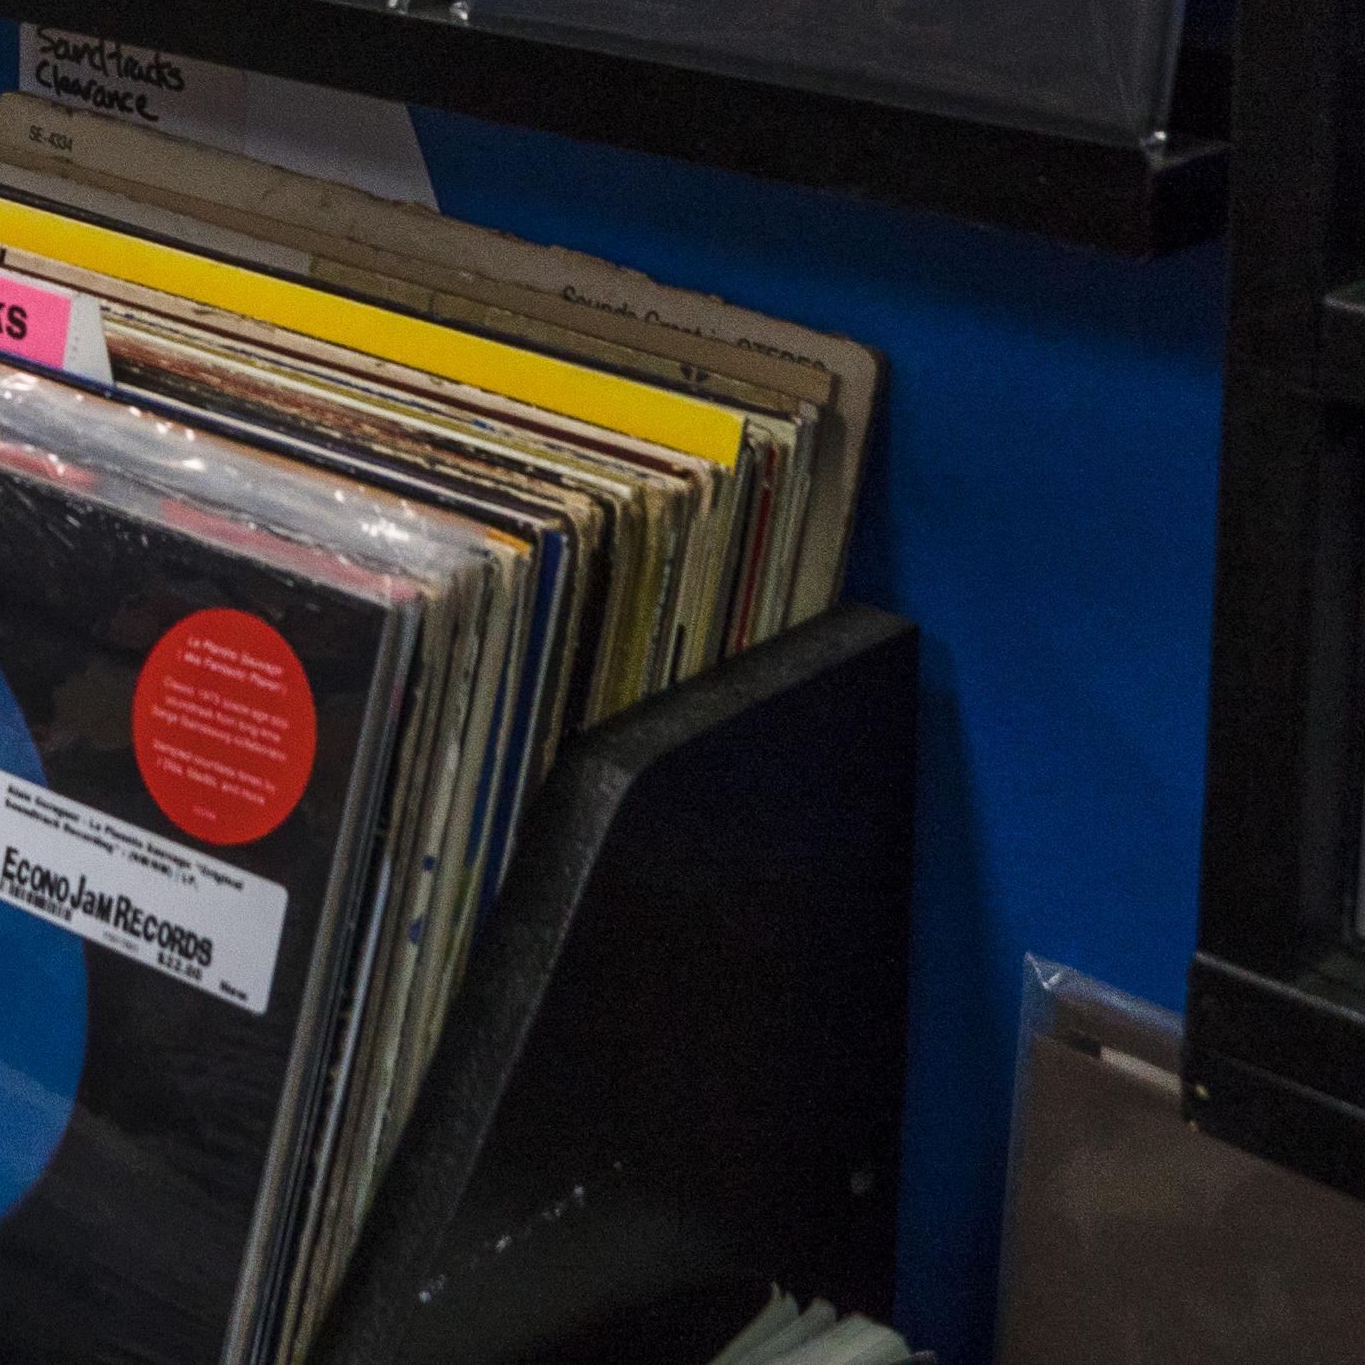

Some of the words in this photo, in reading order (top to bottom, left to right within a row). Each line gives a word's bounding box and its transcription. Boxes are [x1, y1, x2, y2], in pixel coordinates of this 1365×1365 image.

[35, 58, 160, 123] Clearance
[36, 27, 186, 93] Soundtracks
[219, 978, 247, 1002] New
